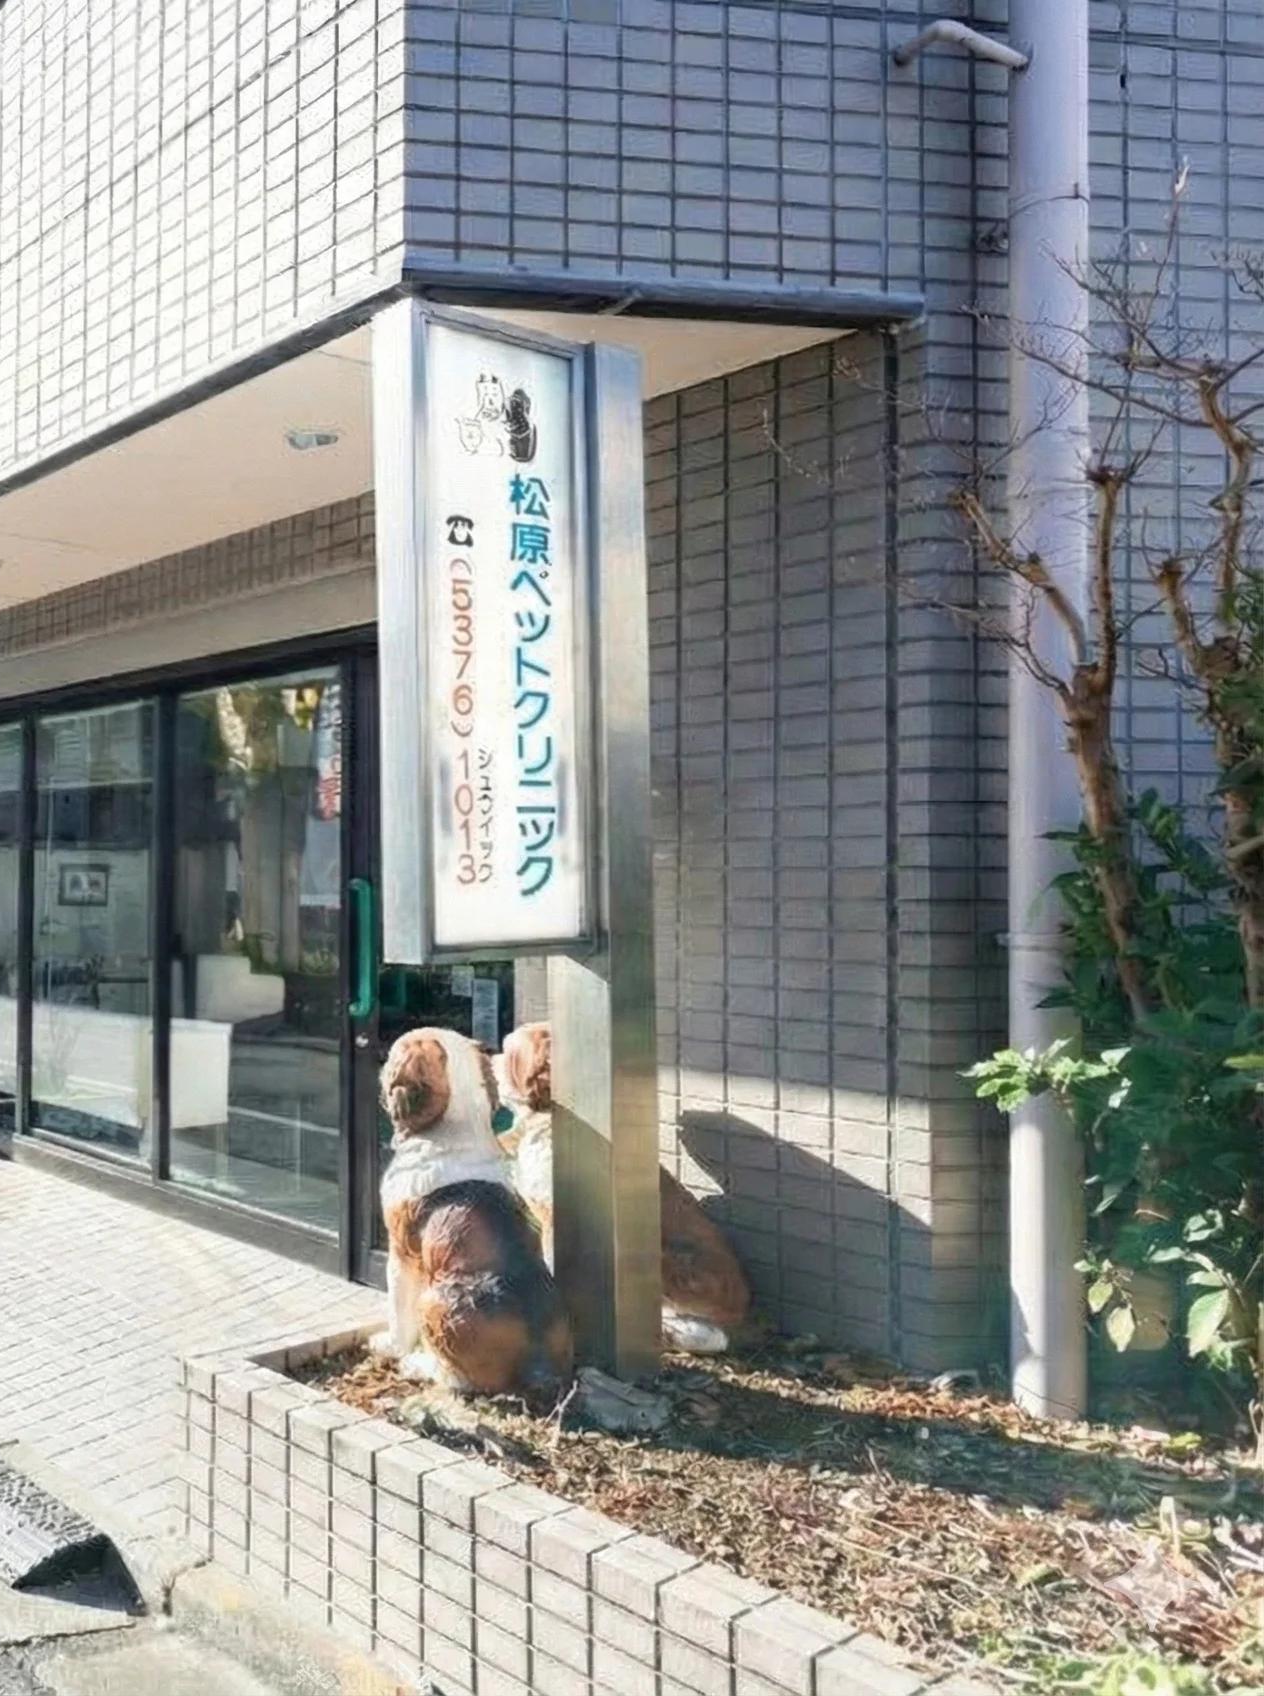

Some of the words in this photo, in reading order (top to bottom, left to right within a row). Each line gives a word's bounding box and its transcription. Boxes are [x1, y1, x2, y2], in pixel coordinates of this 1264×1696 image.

[509, 473, 556, 897] 松原ペットクリニック
